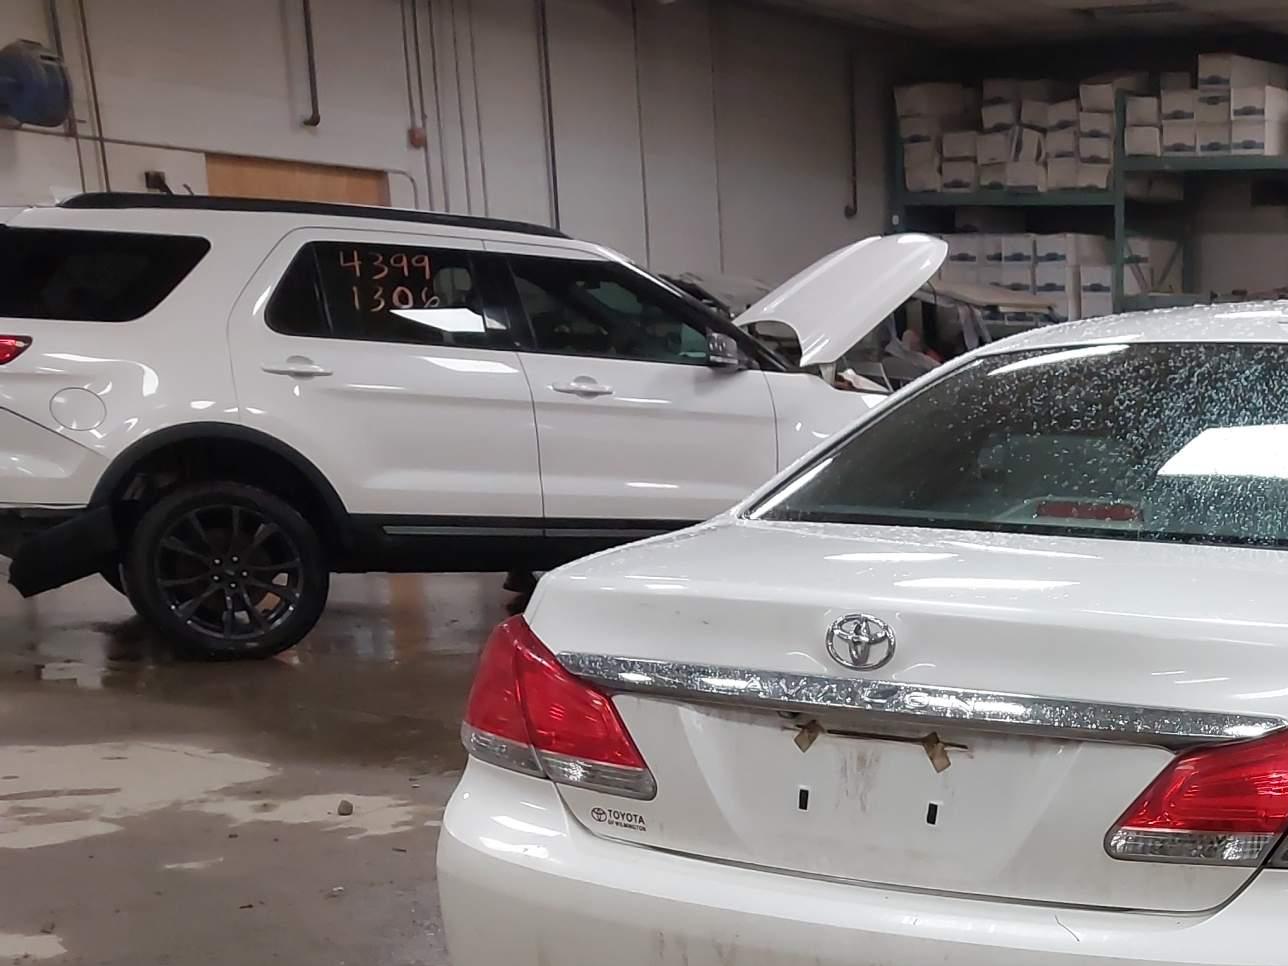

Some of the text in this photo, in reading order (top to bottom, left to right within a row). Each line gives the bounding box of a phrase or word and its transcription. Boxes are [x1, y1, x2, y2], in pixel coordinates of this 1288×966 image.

[340, 249, 430, 280] 4399
[352, 285, 440, 312] 1306
[607, 809, 646, 825] TOYOTA
